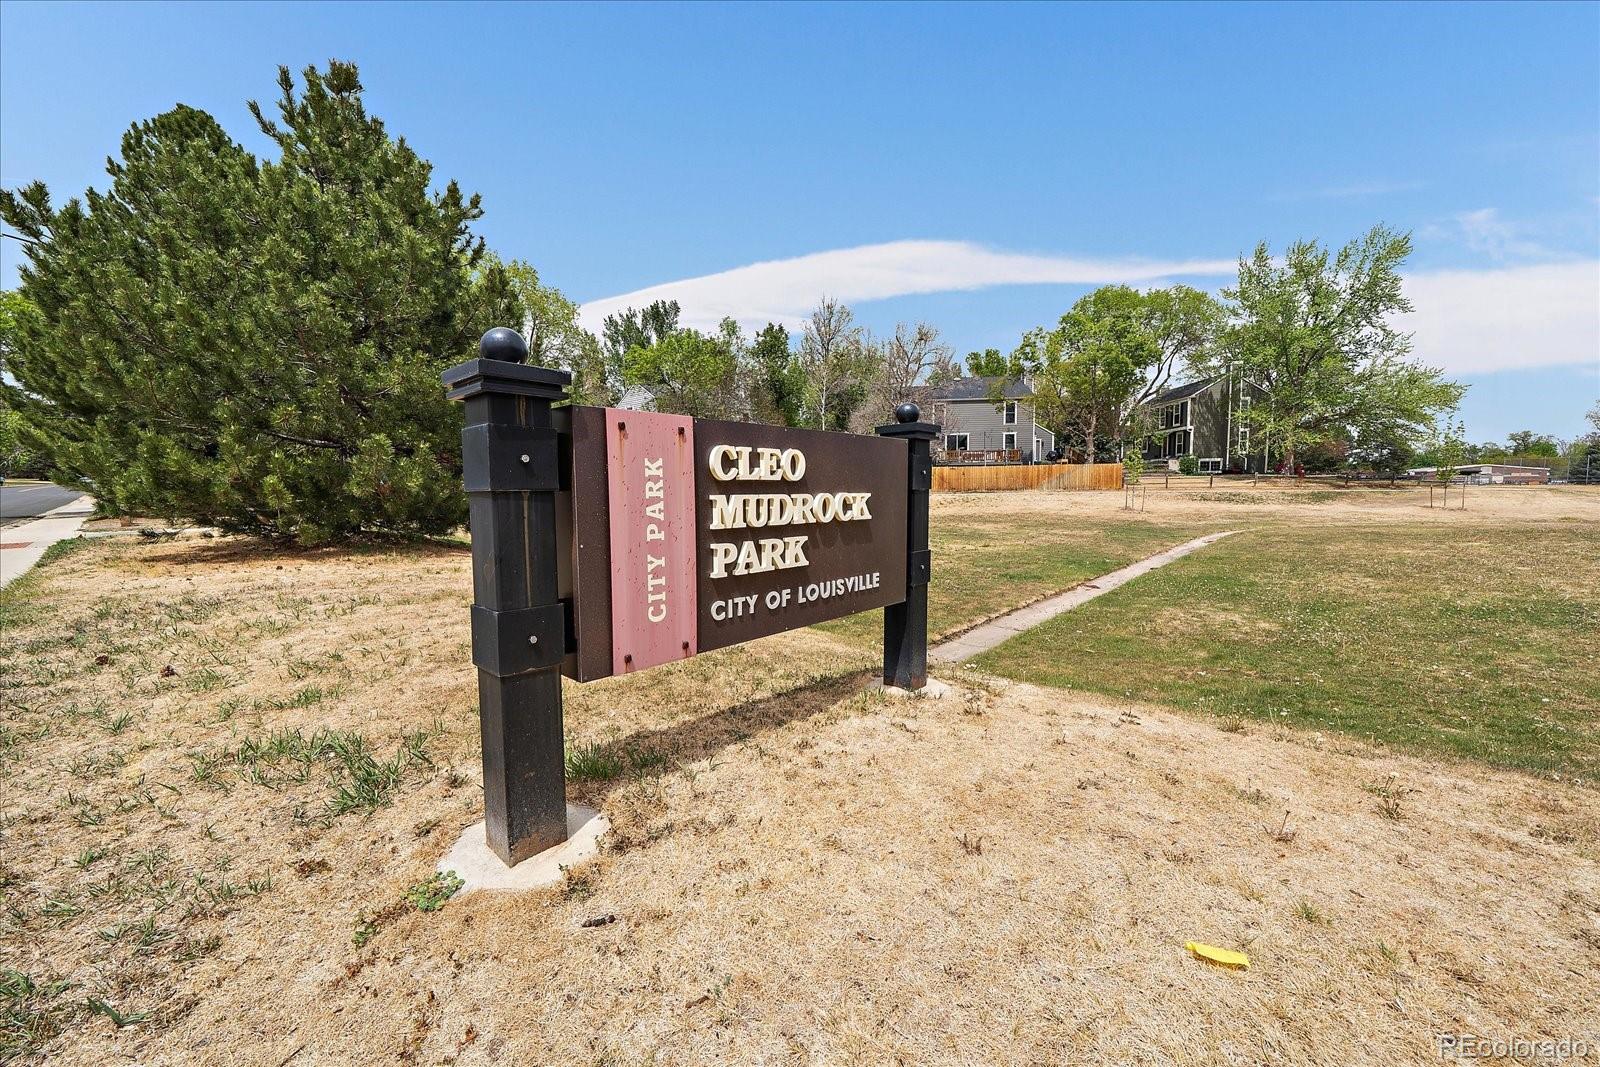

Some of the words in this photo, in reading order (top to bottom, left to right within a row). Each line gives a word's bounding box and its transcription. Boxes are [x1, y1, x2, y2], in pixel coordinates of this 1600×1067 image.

[709, 444, 806, 482] CLEO
[645, 457, 665, 542] PARK
[709, 492, 872, 530] MUDROCK
[709, 535, 809, 579] PARK
[647, 554, 667, 623] CITY
[710, 594, 758, 621] CITY
[765, 588, 791, 610] OF
[798, 572, 880, 604] LOUISVILLE
